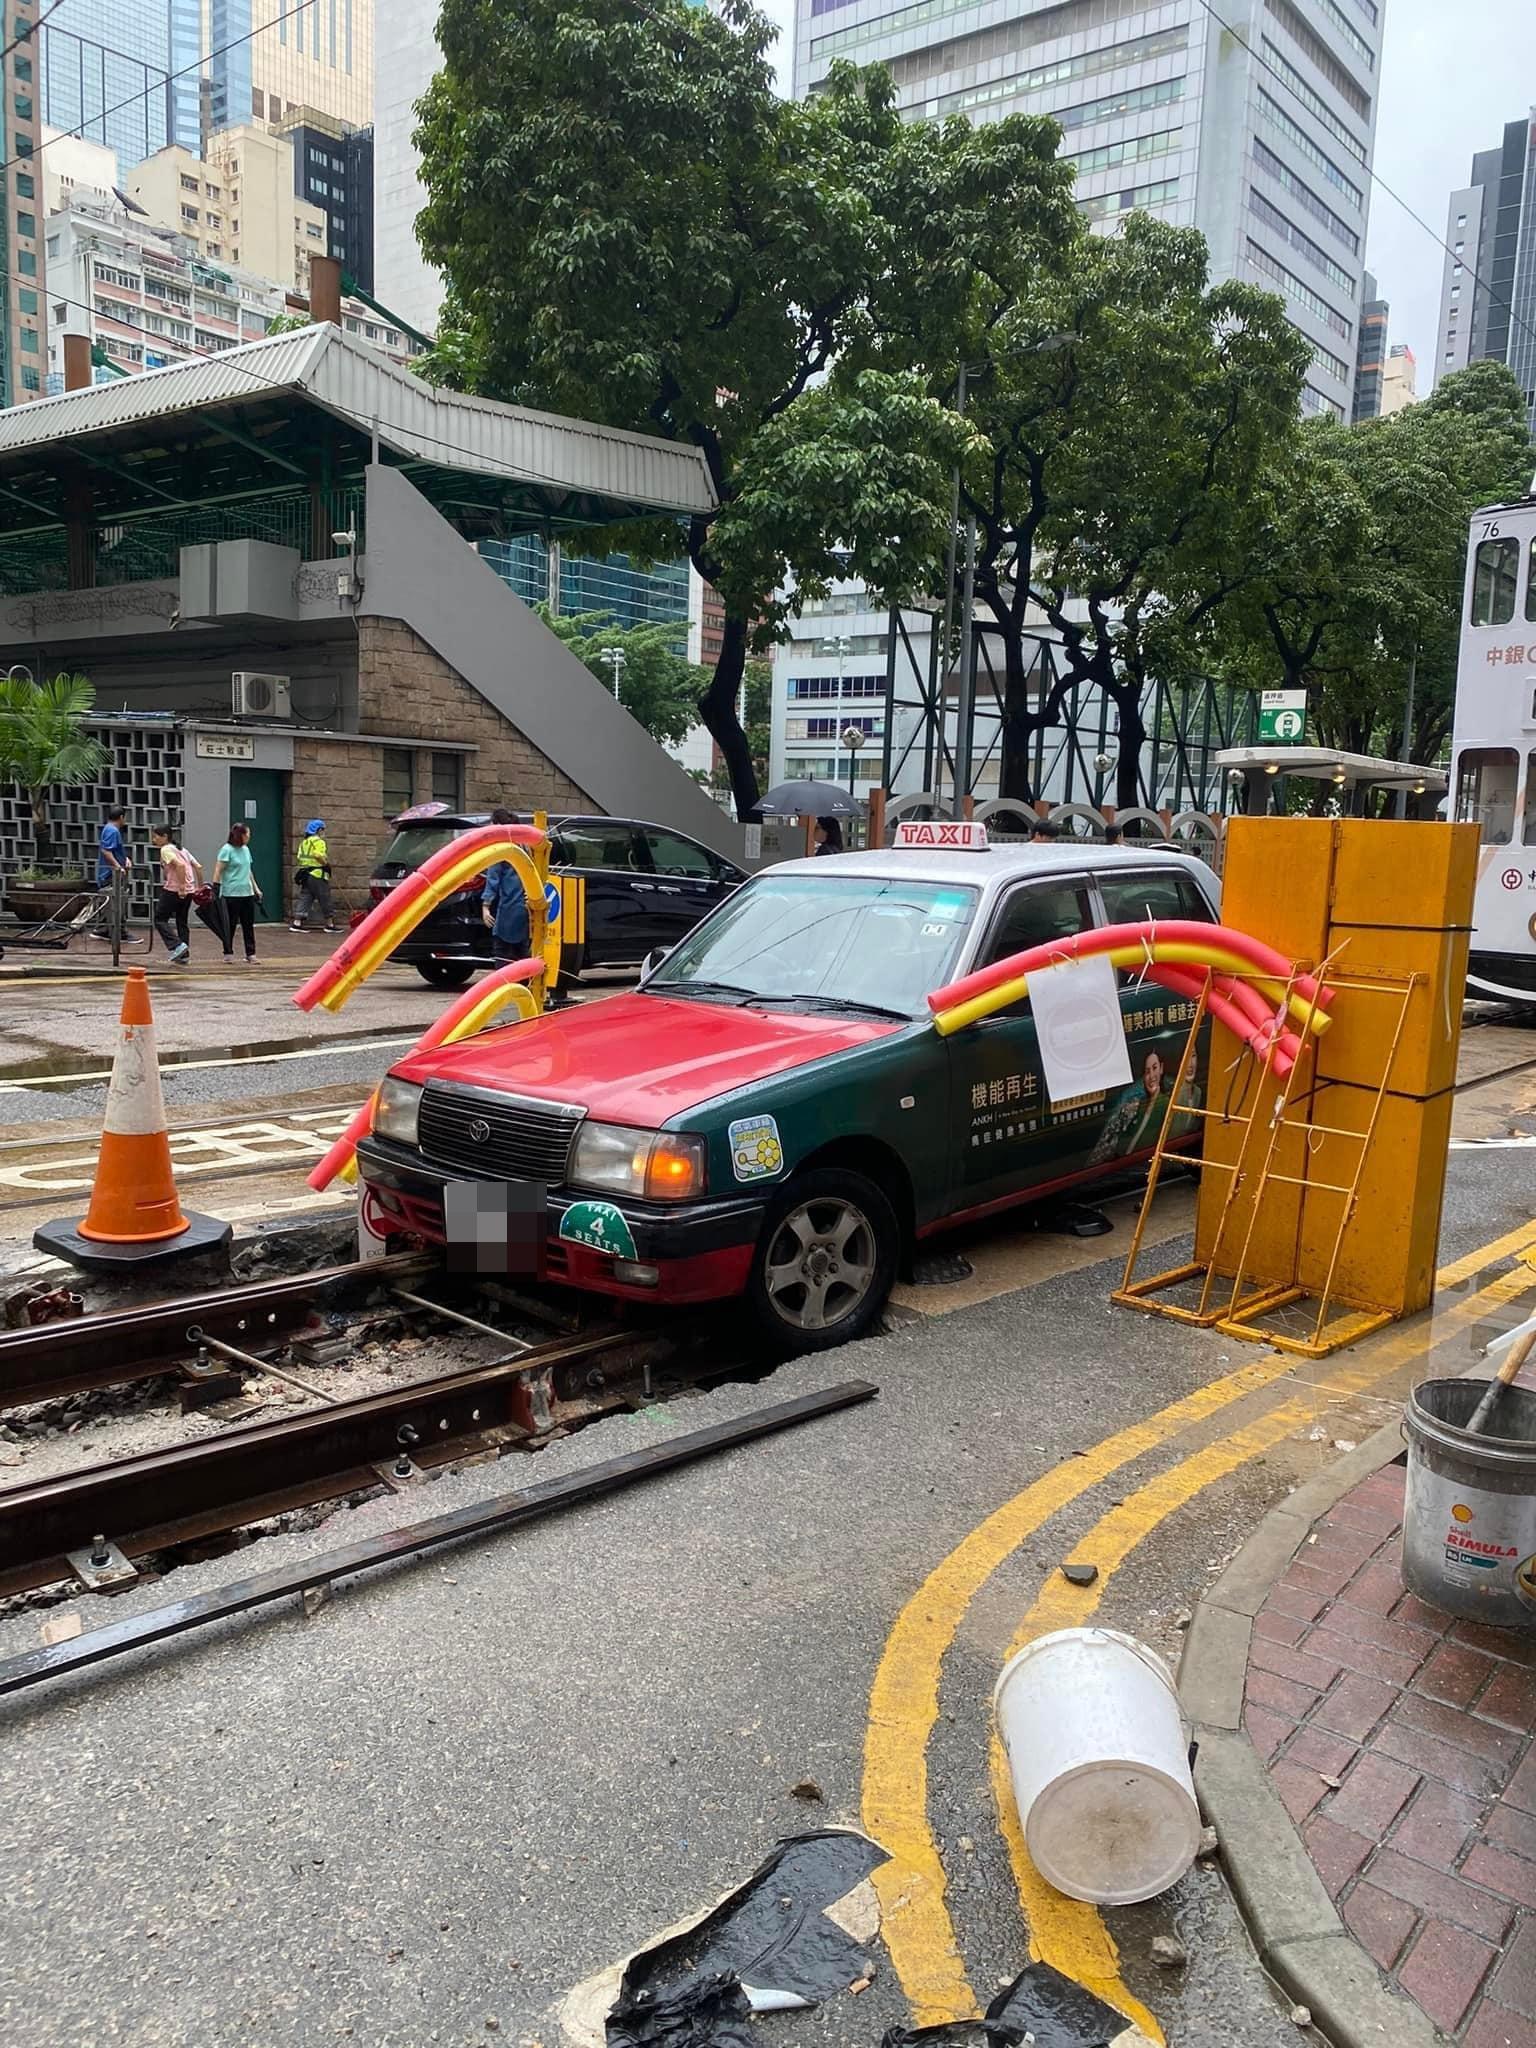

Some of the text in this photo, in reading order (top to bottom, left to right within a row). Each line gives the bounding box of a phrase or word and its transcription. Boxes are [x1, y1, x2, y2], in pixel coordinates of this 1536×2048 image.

[1482, 521, 1500, 538] 76
[901, 824, 972, 845] TAXI
[971, 1072, 1038, 1110] 機能再生
[586, 1203, 617, 1221] TAXI
[590, 1217, 605, 1236] 4
[575, 1229, 621, 1254] SEATS
[1449, 1526, 1471, 1538] Shell
[1447, 1533, 1518, 1556] RIMULA
